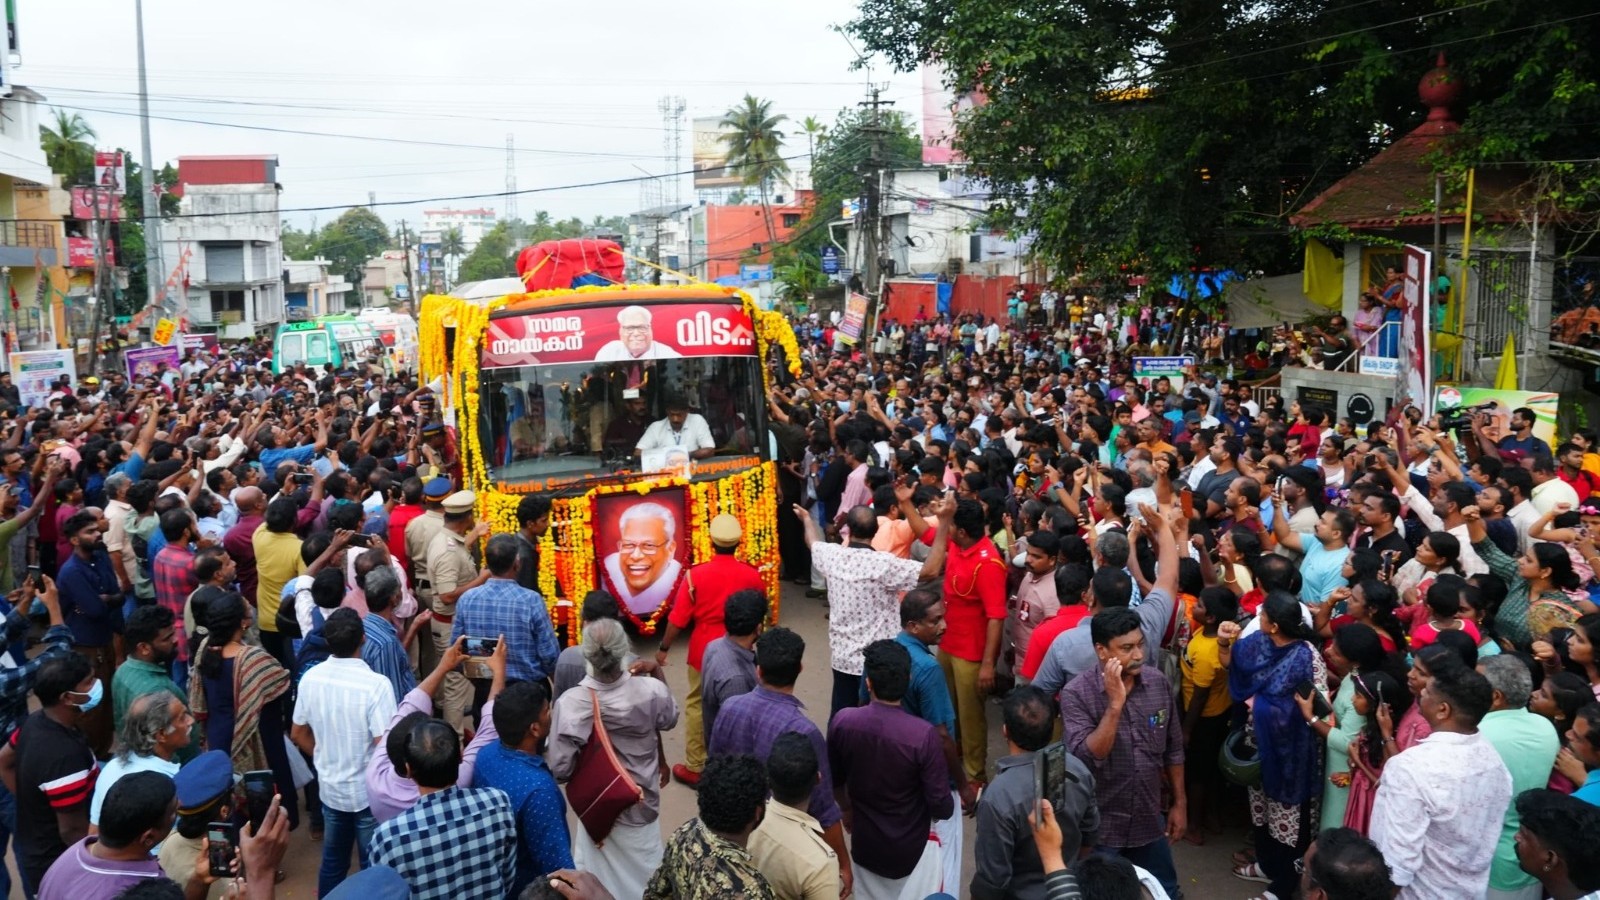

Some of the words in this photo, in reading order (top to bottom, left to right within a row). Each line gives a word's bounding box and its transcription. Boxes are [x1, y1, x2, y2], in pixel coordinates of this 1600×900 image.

[528, 316, 582, 334] സമര
[492, 331, 584, 356] നായകന്
[497, 481, 543, 495] Kerala
[690, 456, 761, 475] Corporation
